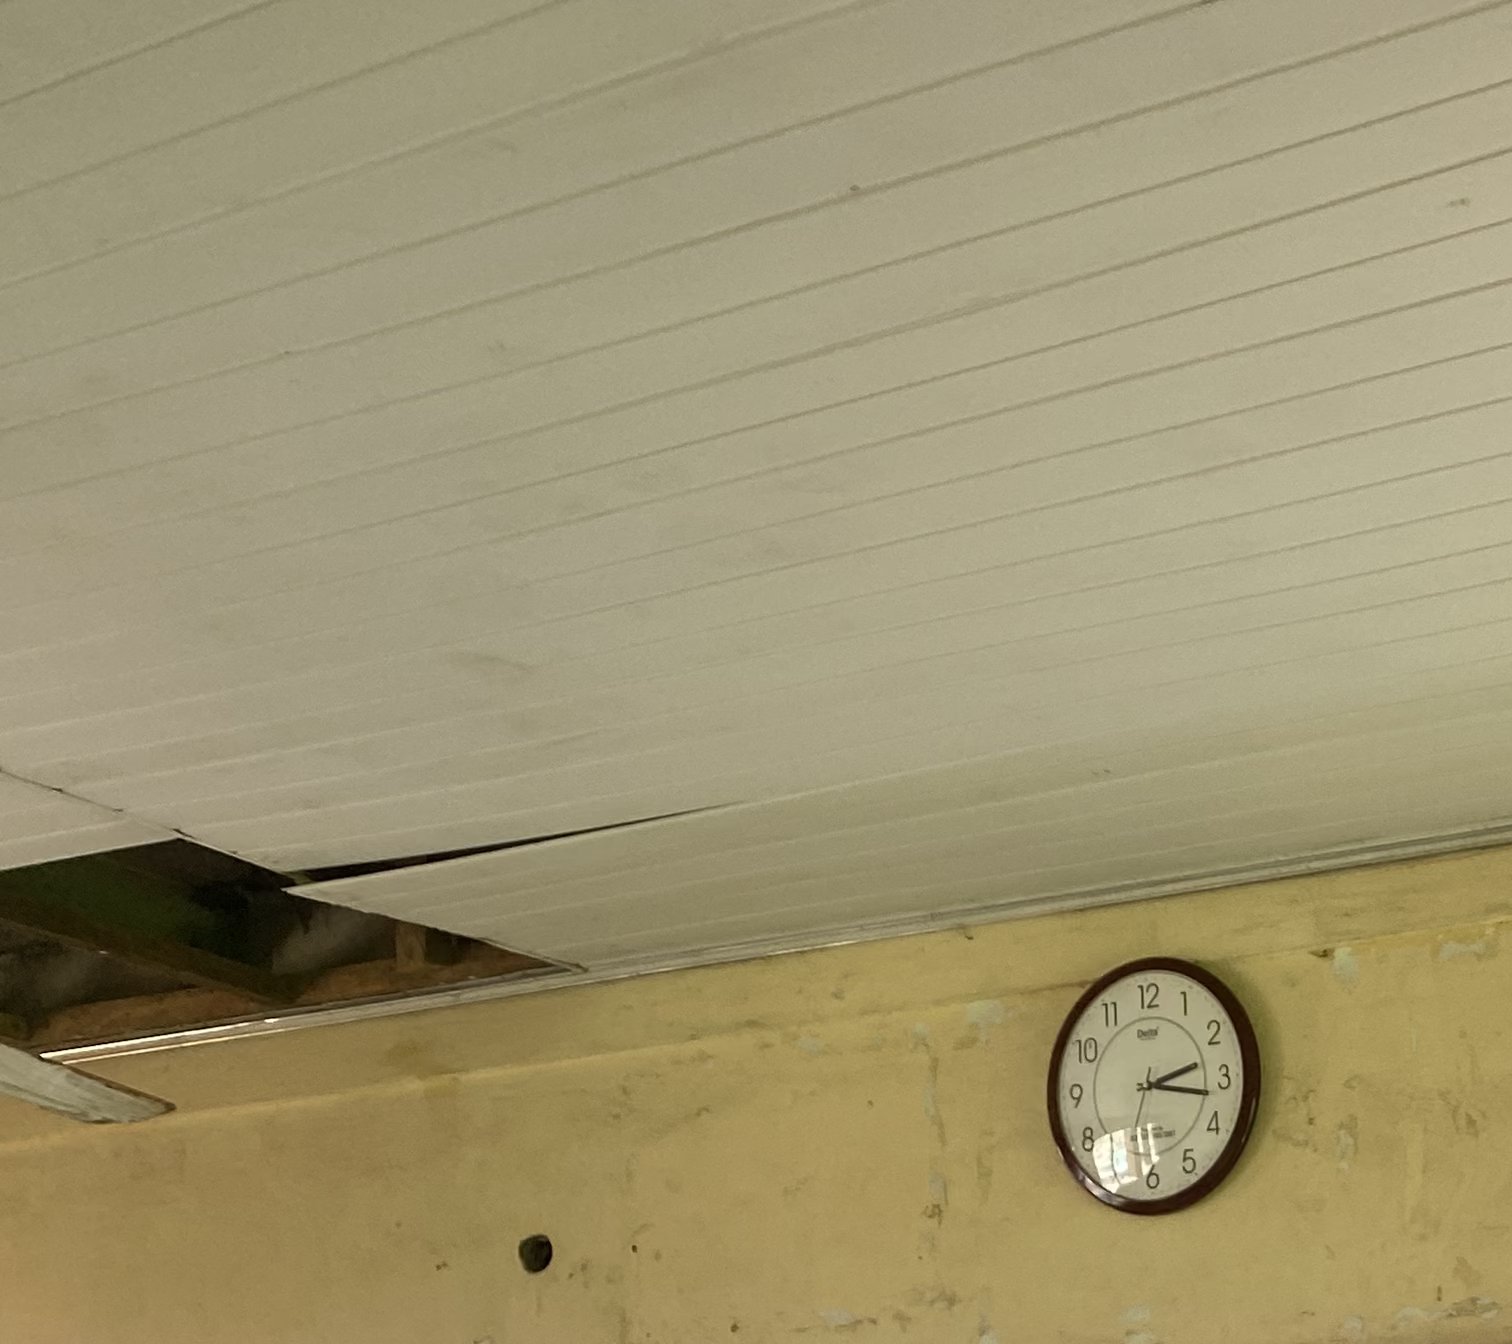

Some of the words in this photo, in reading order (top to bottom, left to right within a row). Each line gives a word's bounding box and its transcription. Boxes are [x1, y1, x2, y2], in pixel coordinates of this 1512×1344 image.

[1137, 983, 1160, 1009] 12
[1180, 991, 1188, 1016] 1
[1101, 1002, 1118, 1027] 11
[1206, 1019, 1221, 1046] 2
[1075, 1037, 1098, 1064] 10
[1217, 1063, 1231, 1090] 3
[1070, 1083, 1084, 1108] 9
[1206, 1110, 1220, 1135] 4
[1082, 1126, 1095, 1152] 8
[1181, 1148, 1197, 1174] 5
[1146, 1163, 1160, 1189] 6
